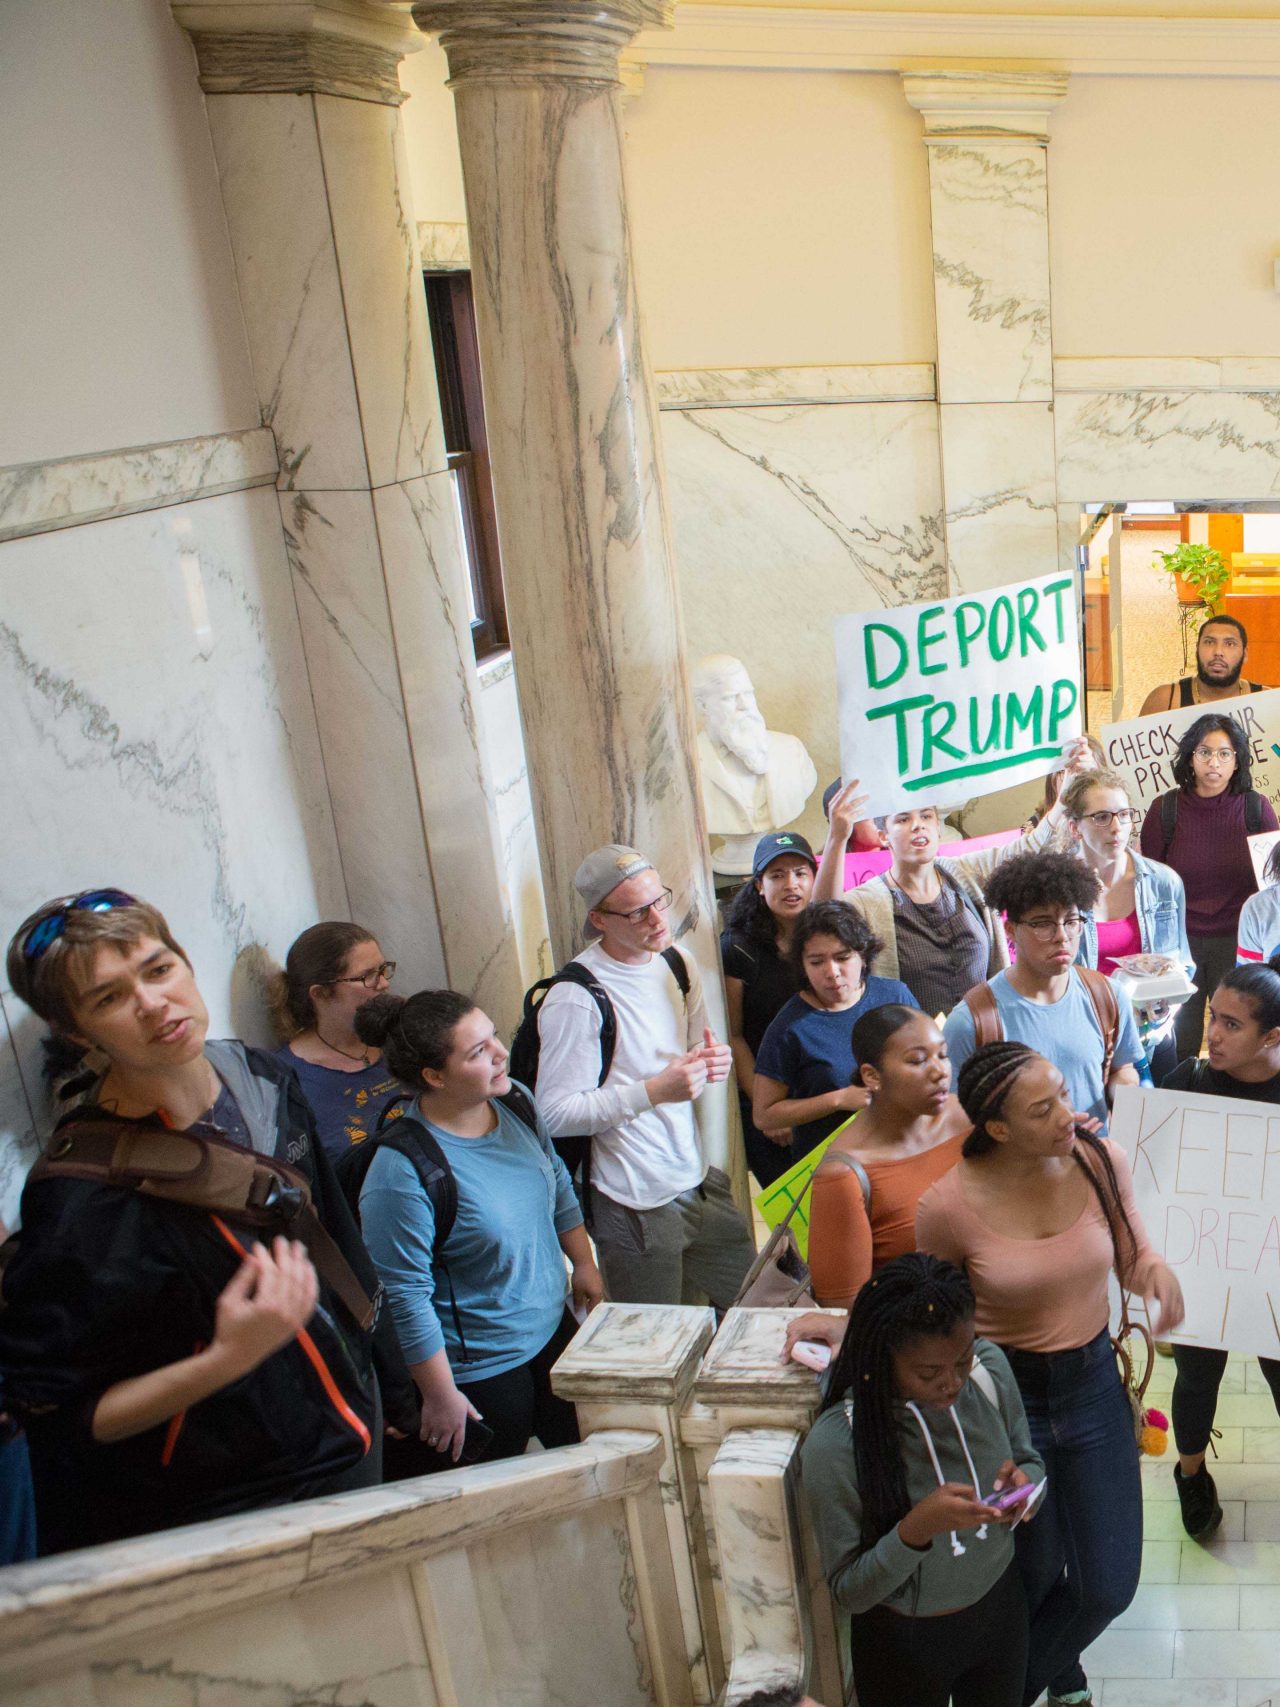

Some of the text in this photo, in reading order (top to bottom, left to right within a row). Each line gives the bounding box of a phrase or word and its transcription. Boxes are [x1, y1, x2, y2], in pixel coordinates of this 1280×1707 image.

[863, 578, 1073, 690] DEPORT
[865, 678, 1078, 777] TRUMP
[1109, 723, 1181, 767] CHECK
